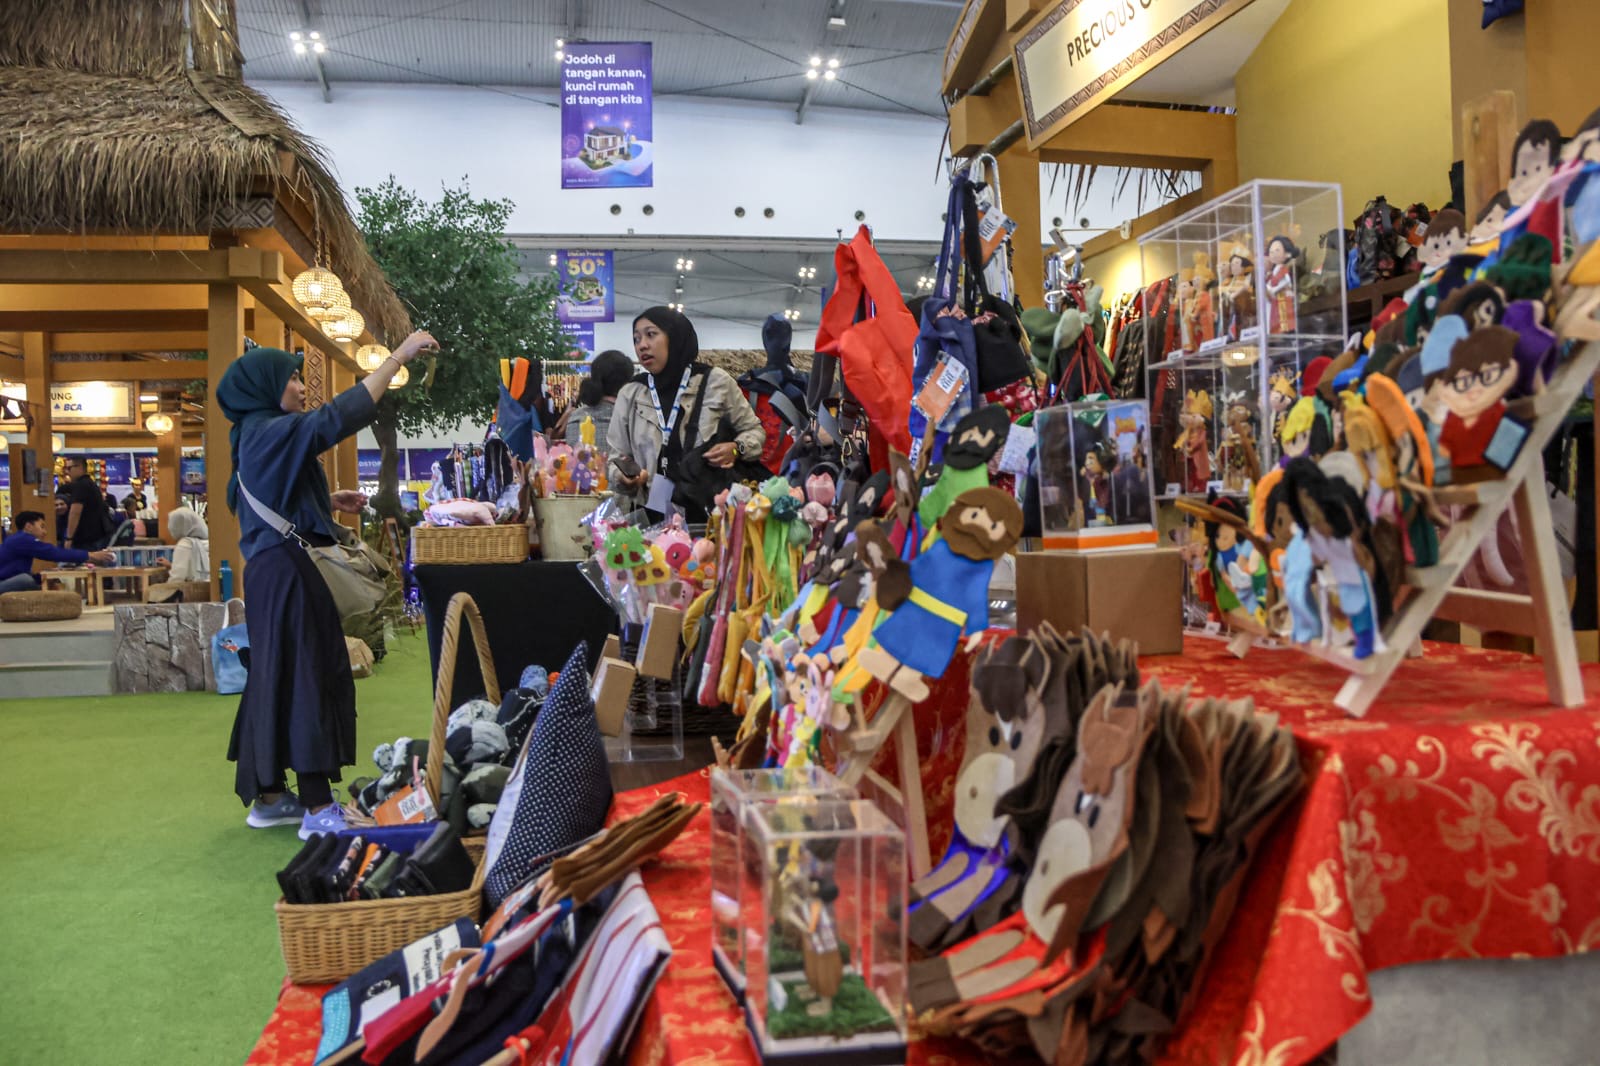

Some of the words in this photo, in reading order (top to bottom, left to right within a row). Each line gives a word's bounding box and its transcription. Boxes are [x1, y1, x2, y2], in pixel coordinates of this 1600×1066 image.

[565, 54, 602, 64] Jodoh
[604, 54, 616, 64] di
[565, 68, 606, 80] tangan
[607, 67, 646, 79] kanan,
[565, 81, 596, 91] kunci
[598, 81, 634, 91] rumah
[565, 94, 577, 105] di
[578, 95, 619, 107] tangan
[620, 94, 643, 105] kita
[63, 403, 82, 411] BCA
